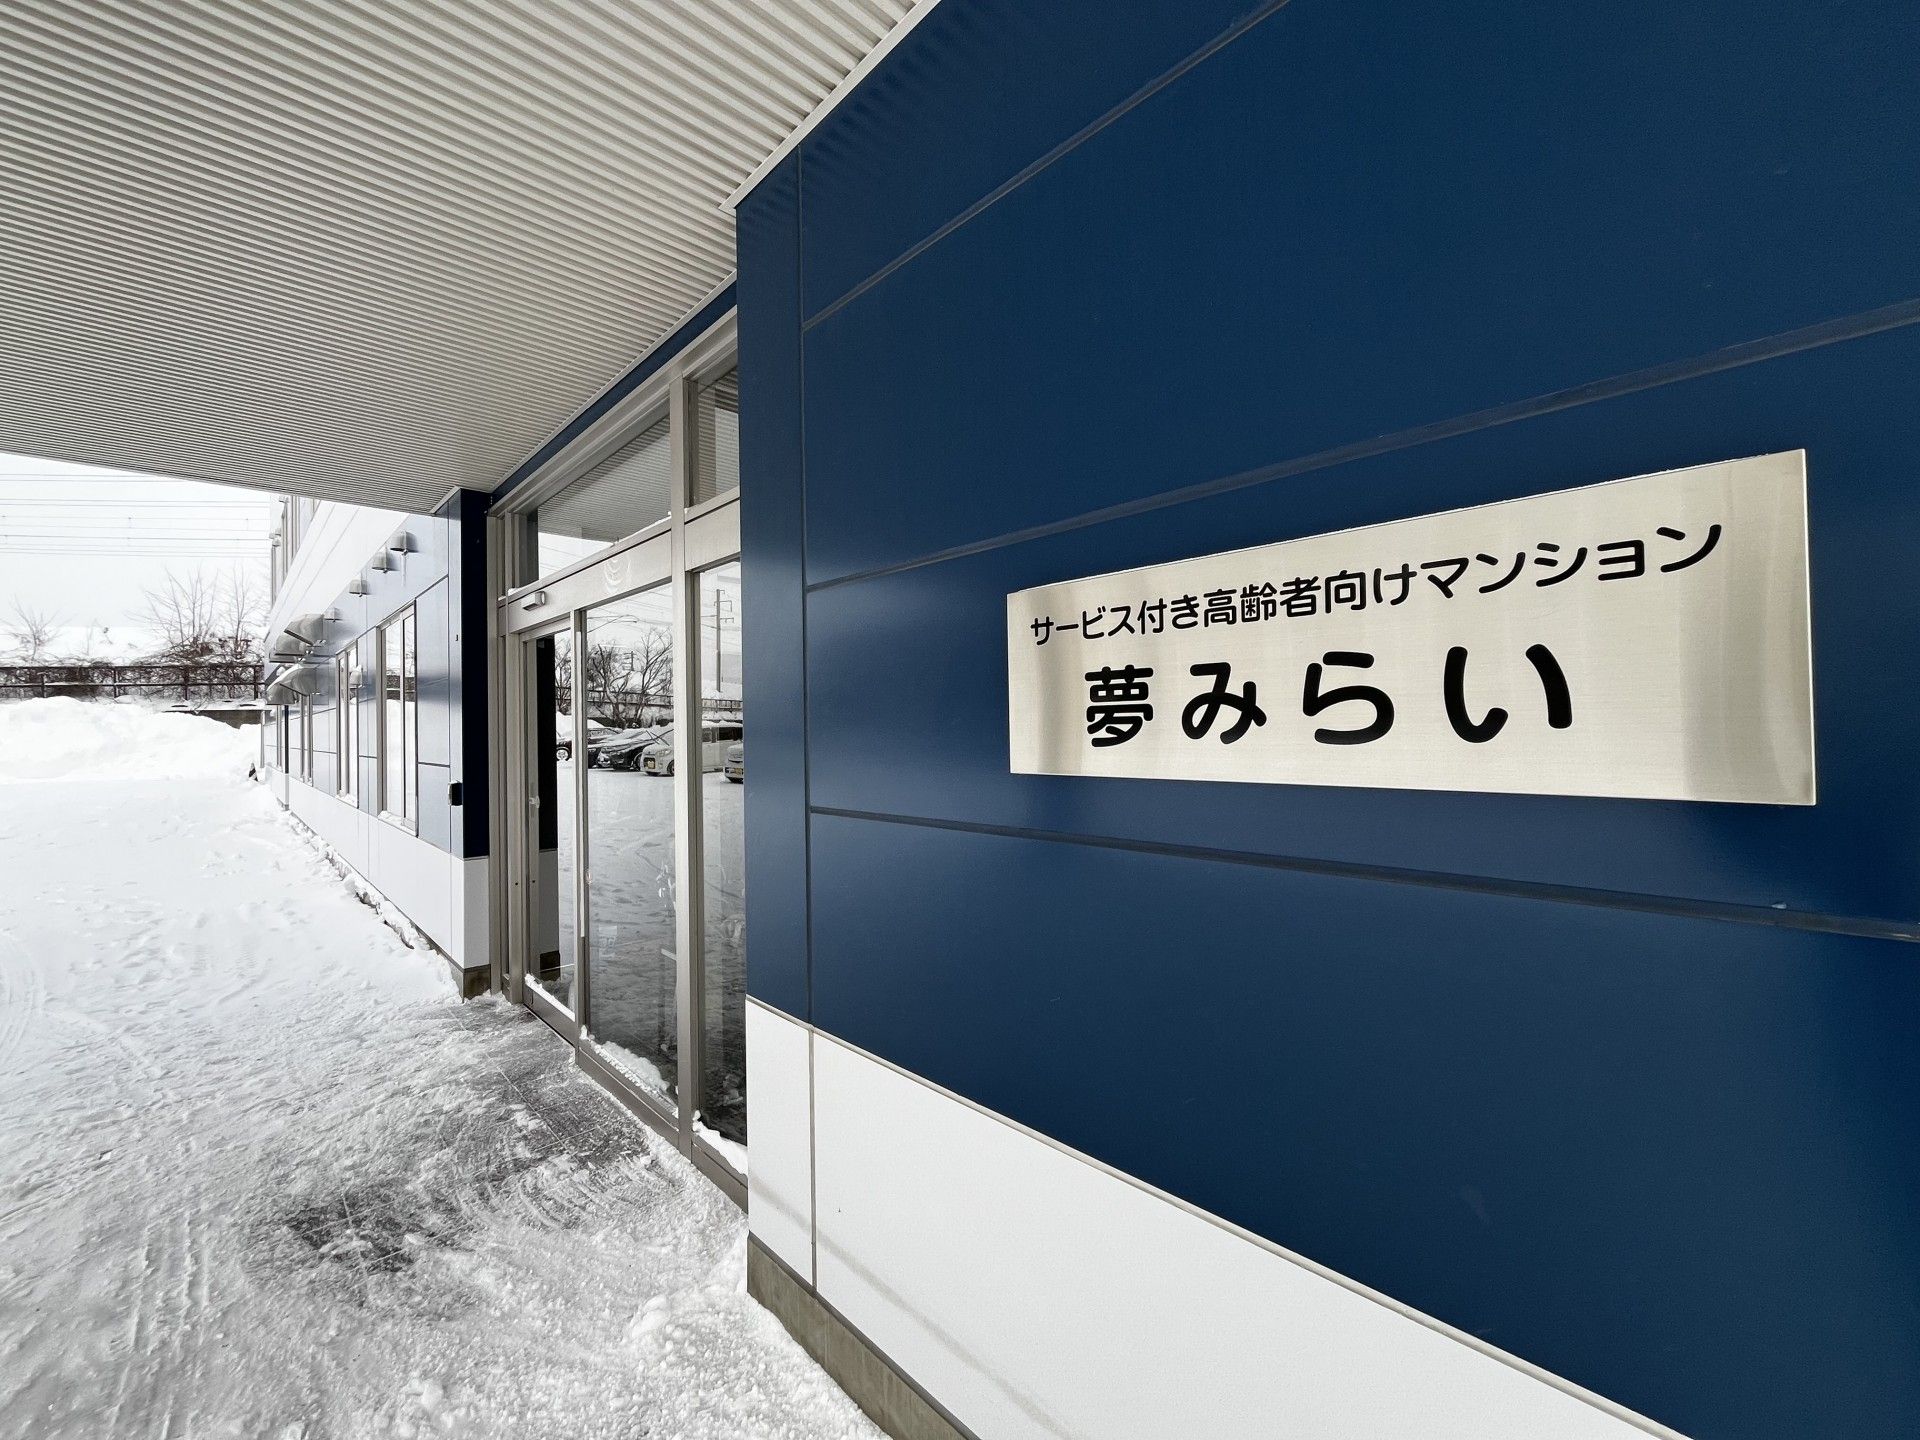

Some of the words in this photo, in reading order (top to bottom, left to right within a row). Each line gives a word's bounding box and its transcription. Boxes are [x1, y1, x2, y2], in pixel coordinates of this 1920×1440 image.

[1030, 524, 1722, 646] サービス付き高齢者向けマンション
[1084, 643, 1573, 748] 夢みらい
